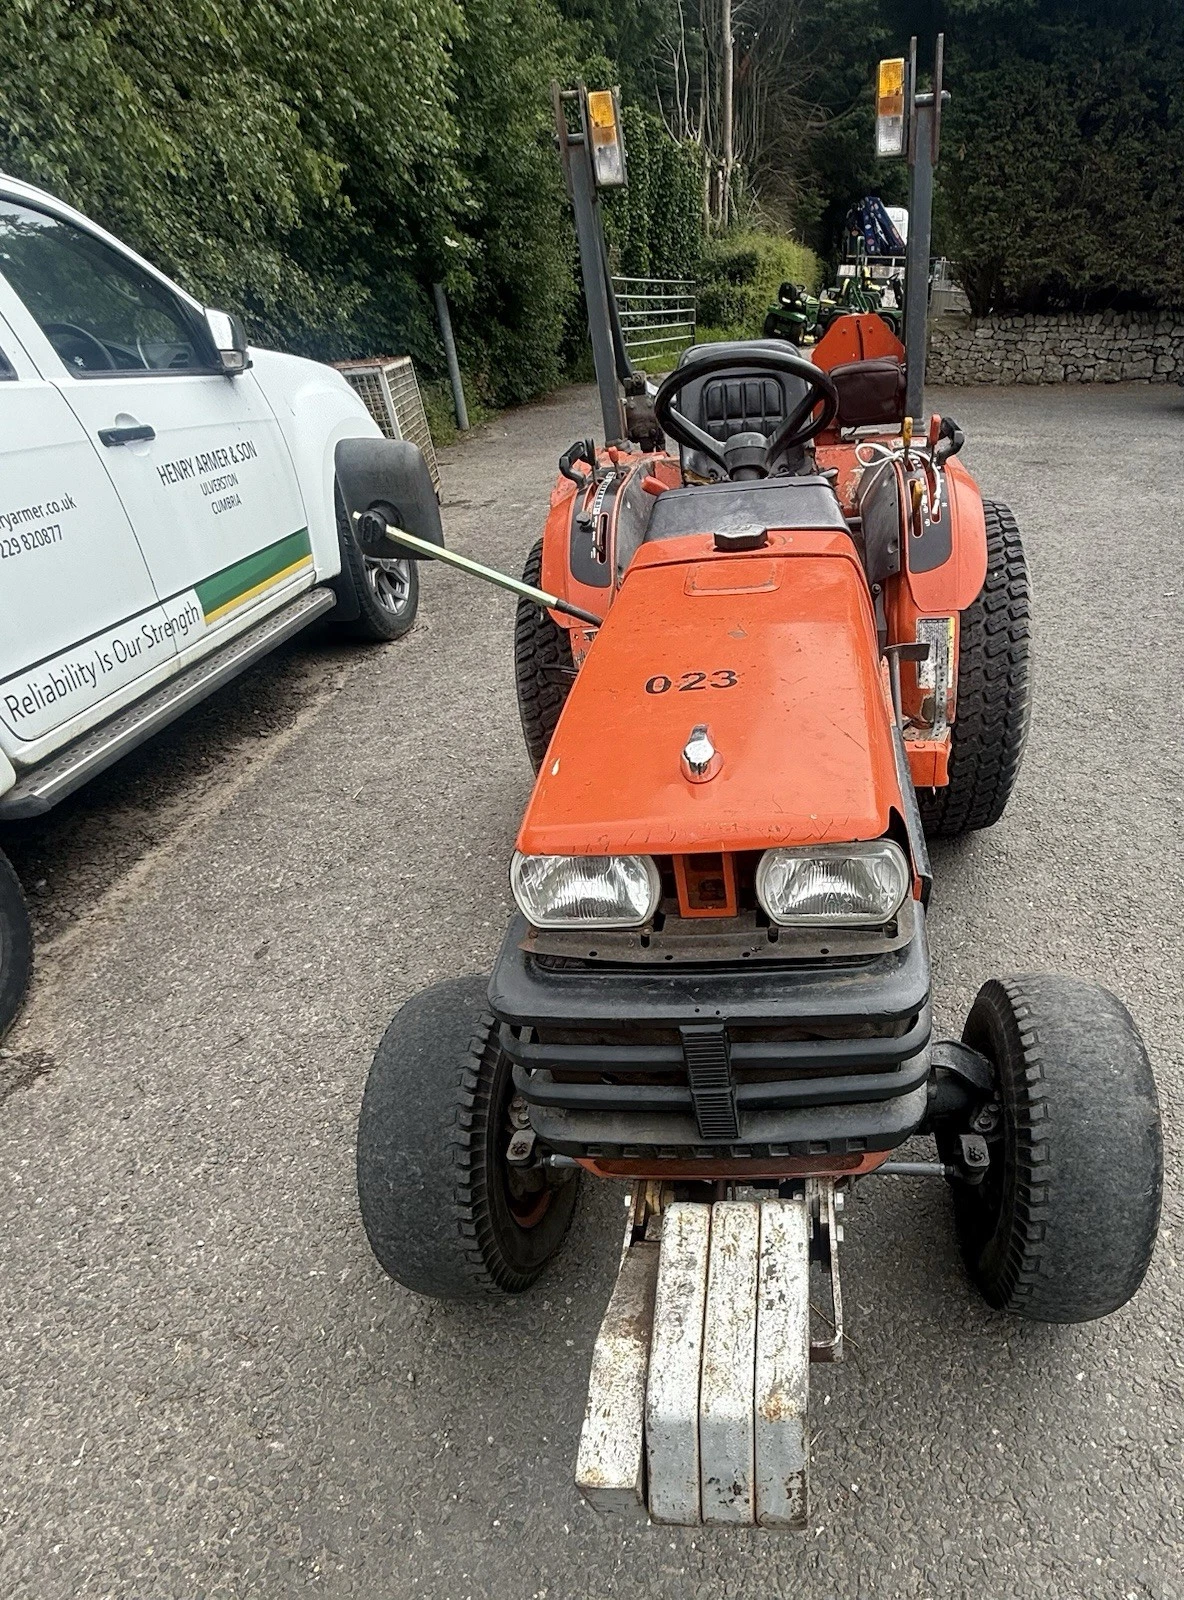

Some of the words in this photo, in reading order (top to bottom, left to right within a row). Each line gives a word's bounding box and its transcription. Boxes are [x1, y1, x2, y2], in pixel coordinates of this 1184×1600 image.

[156, 457, 195, 486] HENRY
[195, 448, 231, 474] ARMER
[228, 445, 239, 464] &
[235, 440, 258, 461] SON
[199, 472, 239, 496] ULVERSTON
[0, 492, 77, 532] ryarmer.co.uk
[211, 493, 242, 515] CUMBRIA
[20, 524, 62, 551] 820877
[4, 661, 97, 723] Reliability
[94, 650, 114, 674] Is
[112, 636, 142, 664] Our
[141, 601, 200, 649] Strength
[645, 670, 738, 695] 023
